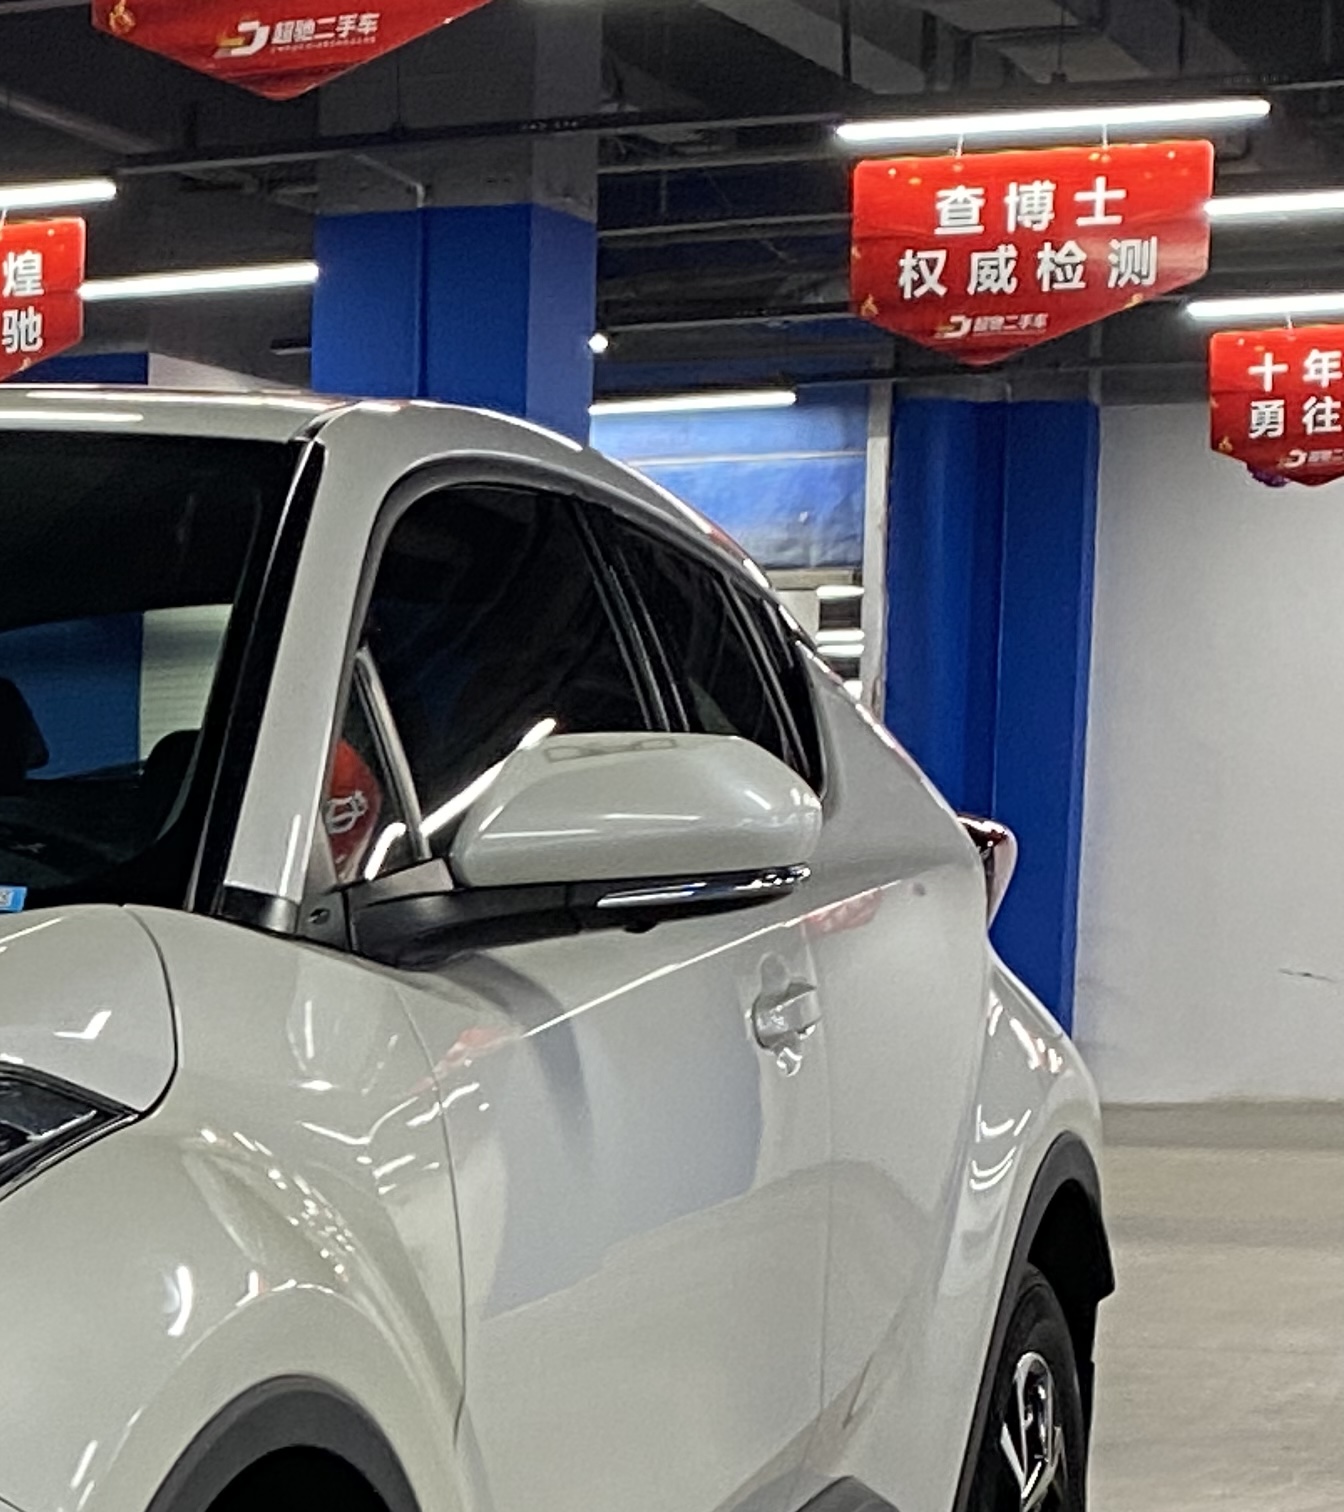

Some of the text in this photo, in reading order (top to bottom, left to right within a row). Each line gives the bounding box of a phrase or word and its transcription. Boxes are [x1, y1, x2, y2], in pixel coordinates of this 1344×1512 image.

[271, 12, 381, 45] 超驰二手车
[934, 175, 1127, 235] 查博士
[898, 236, 1159, 300] 权威检测
[1248, 349, 1344, 392] 十年
[1248, 396, 1343, 439] 勇往
